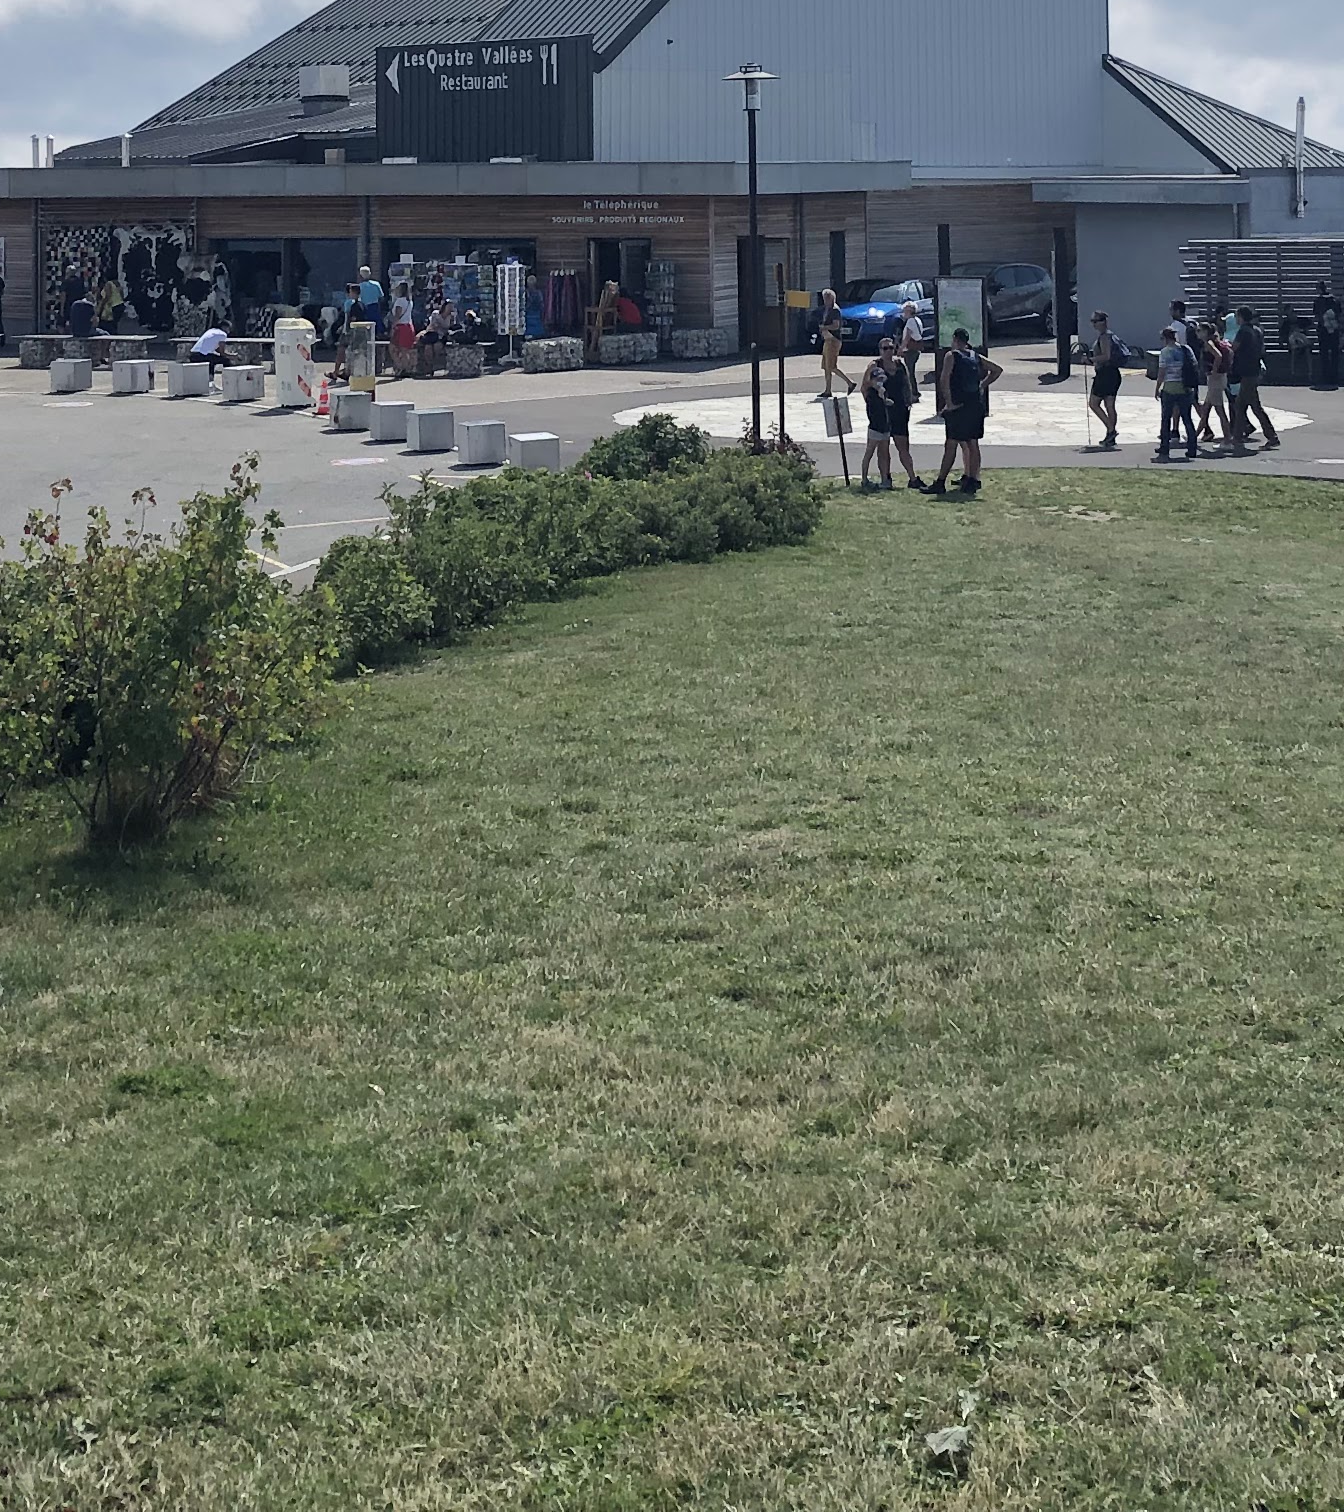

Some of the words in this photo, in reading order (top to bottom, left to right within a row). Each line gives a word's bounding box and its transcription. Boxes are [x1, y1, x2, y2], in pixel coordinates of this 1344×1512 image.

[403, 51, 425, 67] Les
[426, 48, 474, 74] Quatre
[481, 45, 533, 65] Vallées
[440, 72, 509, 91] Restaurant
[599, 216, 636, 224] PRODUITS
